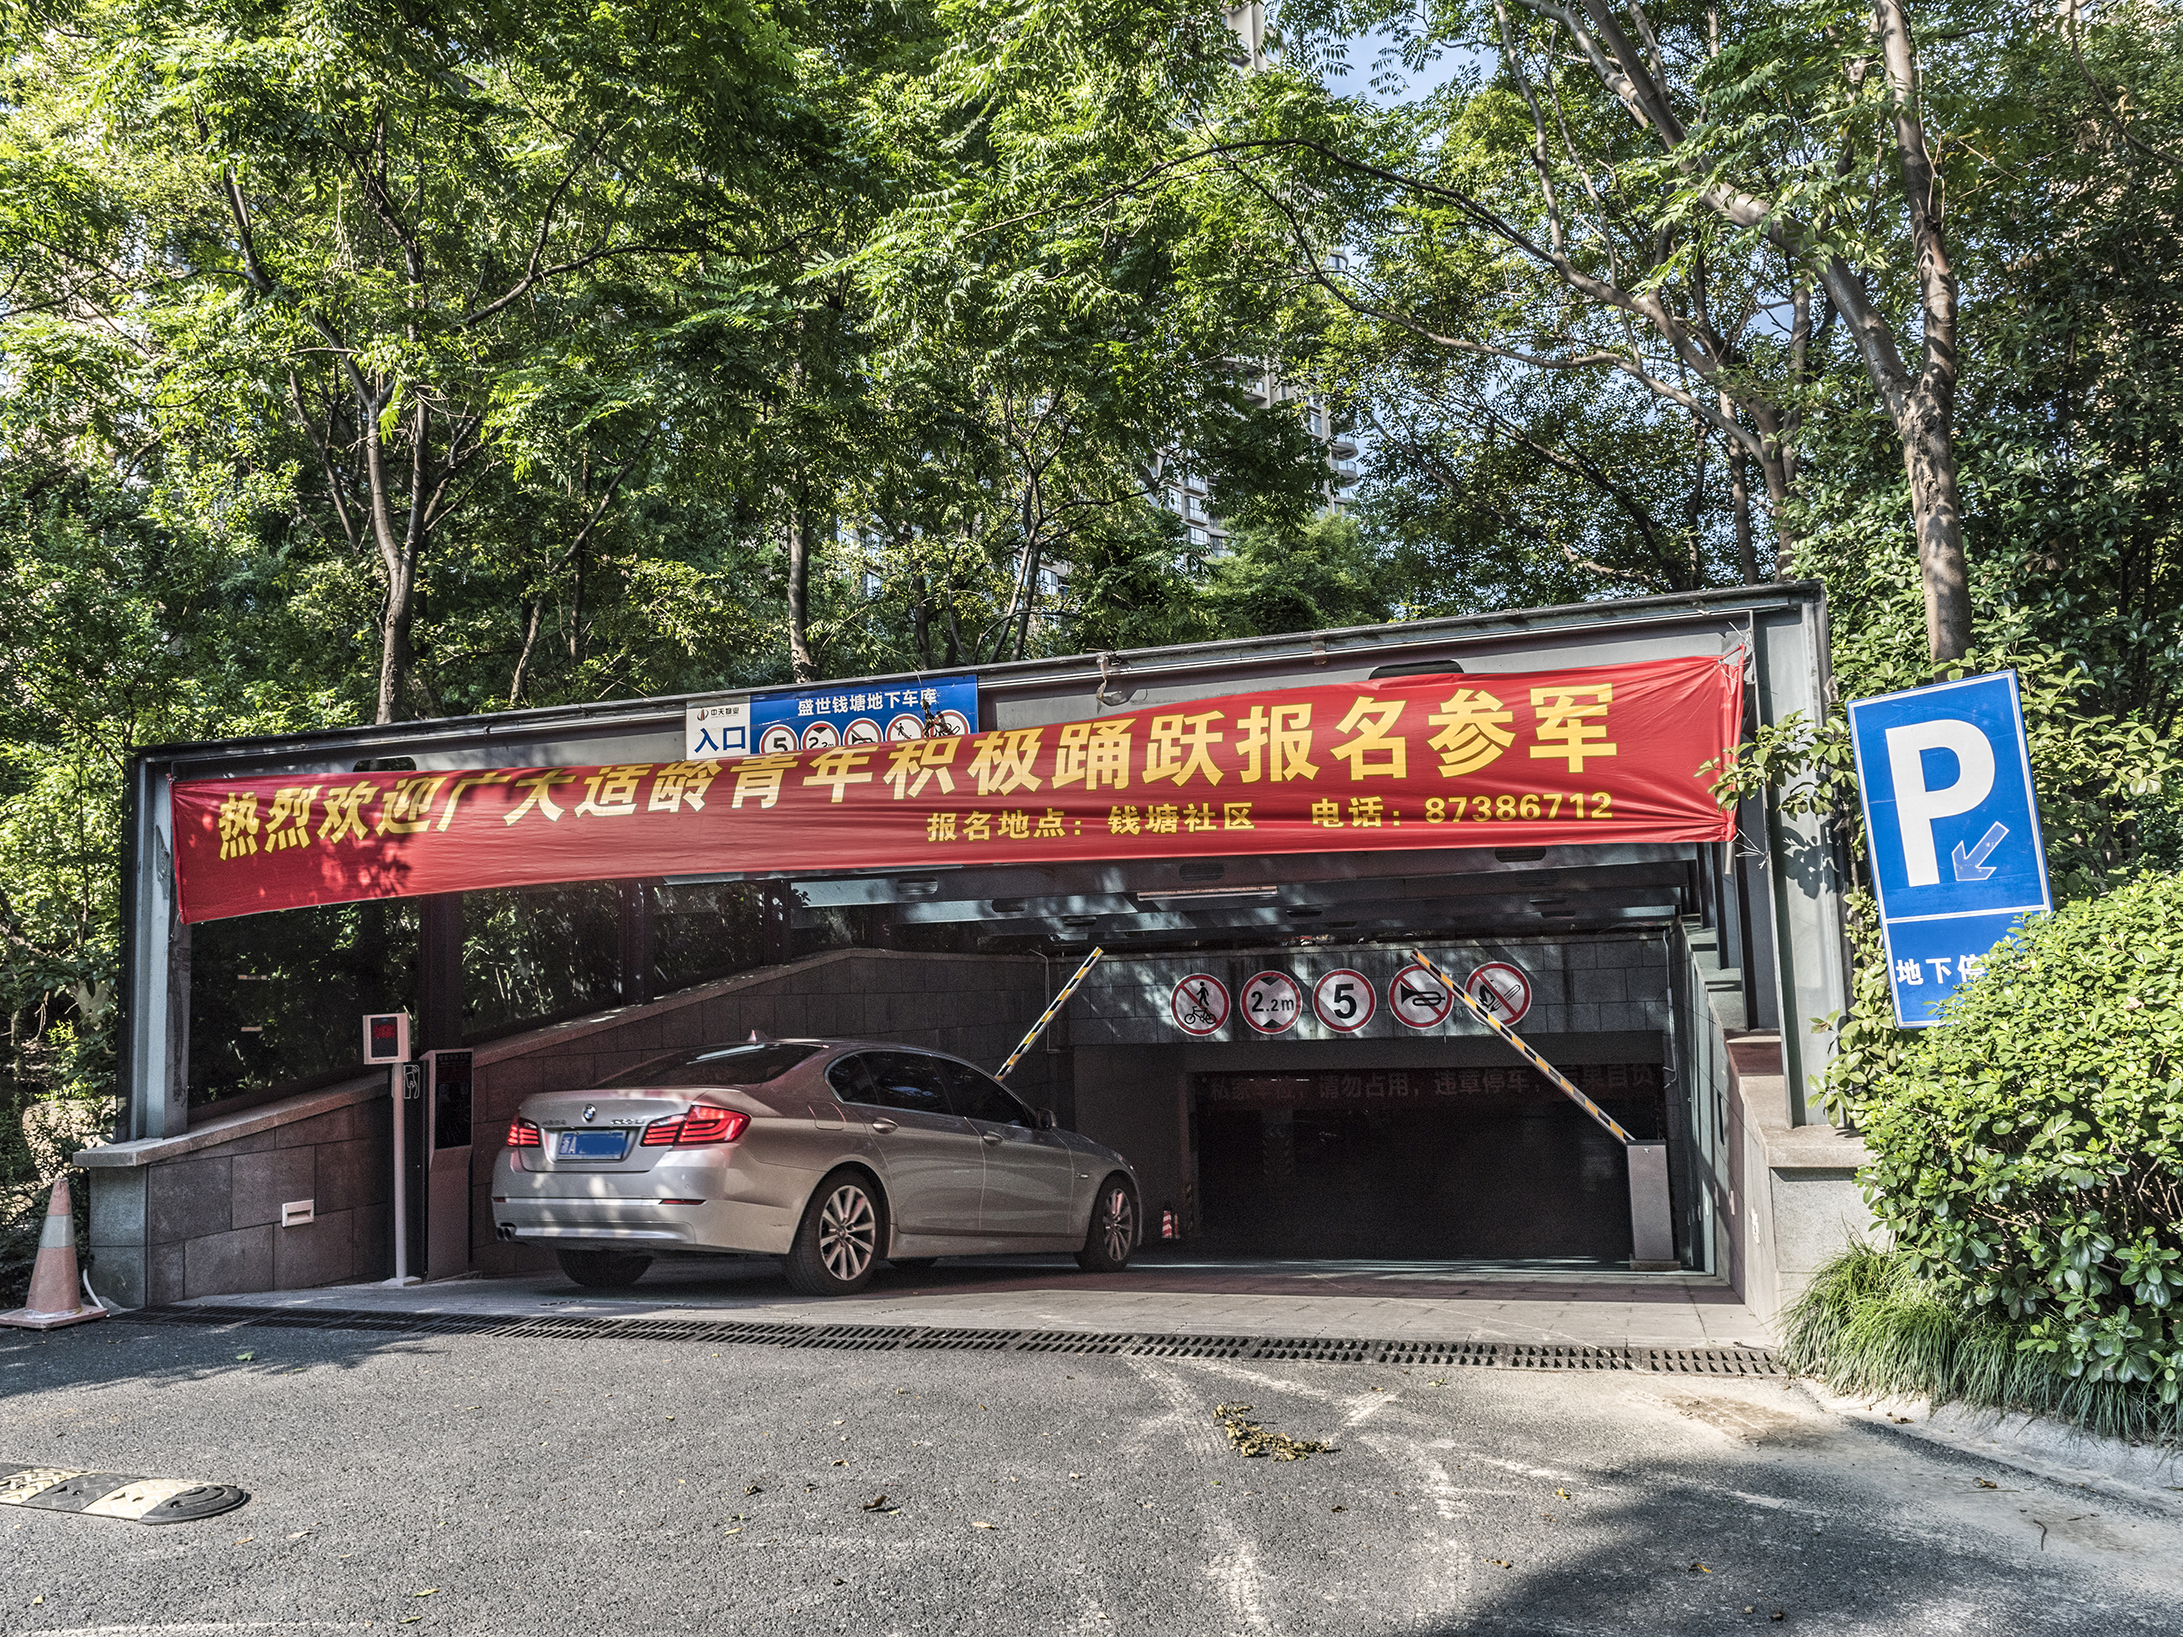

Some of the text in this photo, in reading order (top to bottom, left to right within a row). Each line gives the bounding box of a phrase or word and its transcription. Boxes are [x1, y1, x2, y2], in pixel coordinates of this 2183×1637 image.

[797, 688, 938, 717] 盛世钱塘地下车库
[694, 726, 746, 753] 入口
[773, 737, 788, 752] 5
[218, 682, 1619, 861] 热烈欢迎广大适龄青年积极踊跃报名参军
[926, 791, 1614, 843] 报名地点：钱塘社区 电话：87386712
[1885, 719, 1995, 887] P
[1251, 991, 1295, 1013] 2.2m
[1333, 983, 1358, 1019] 5
